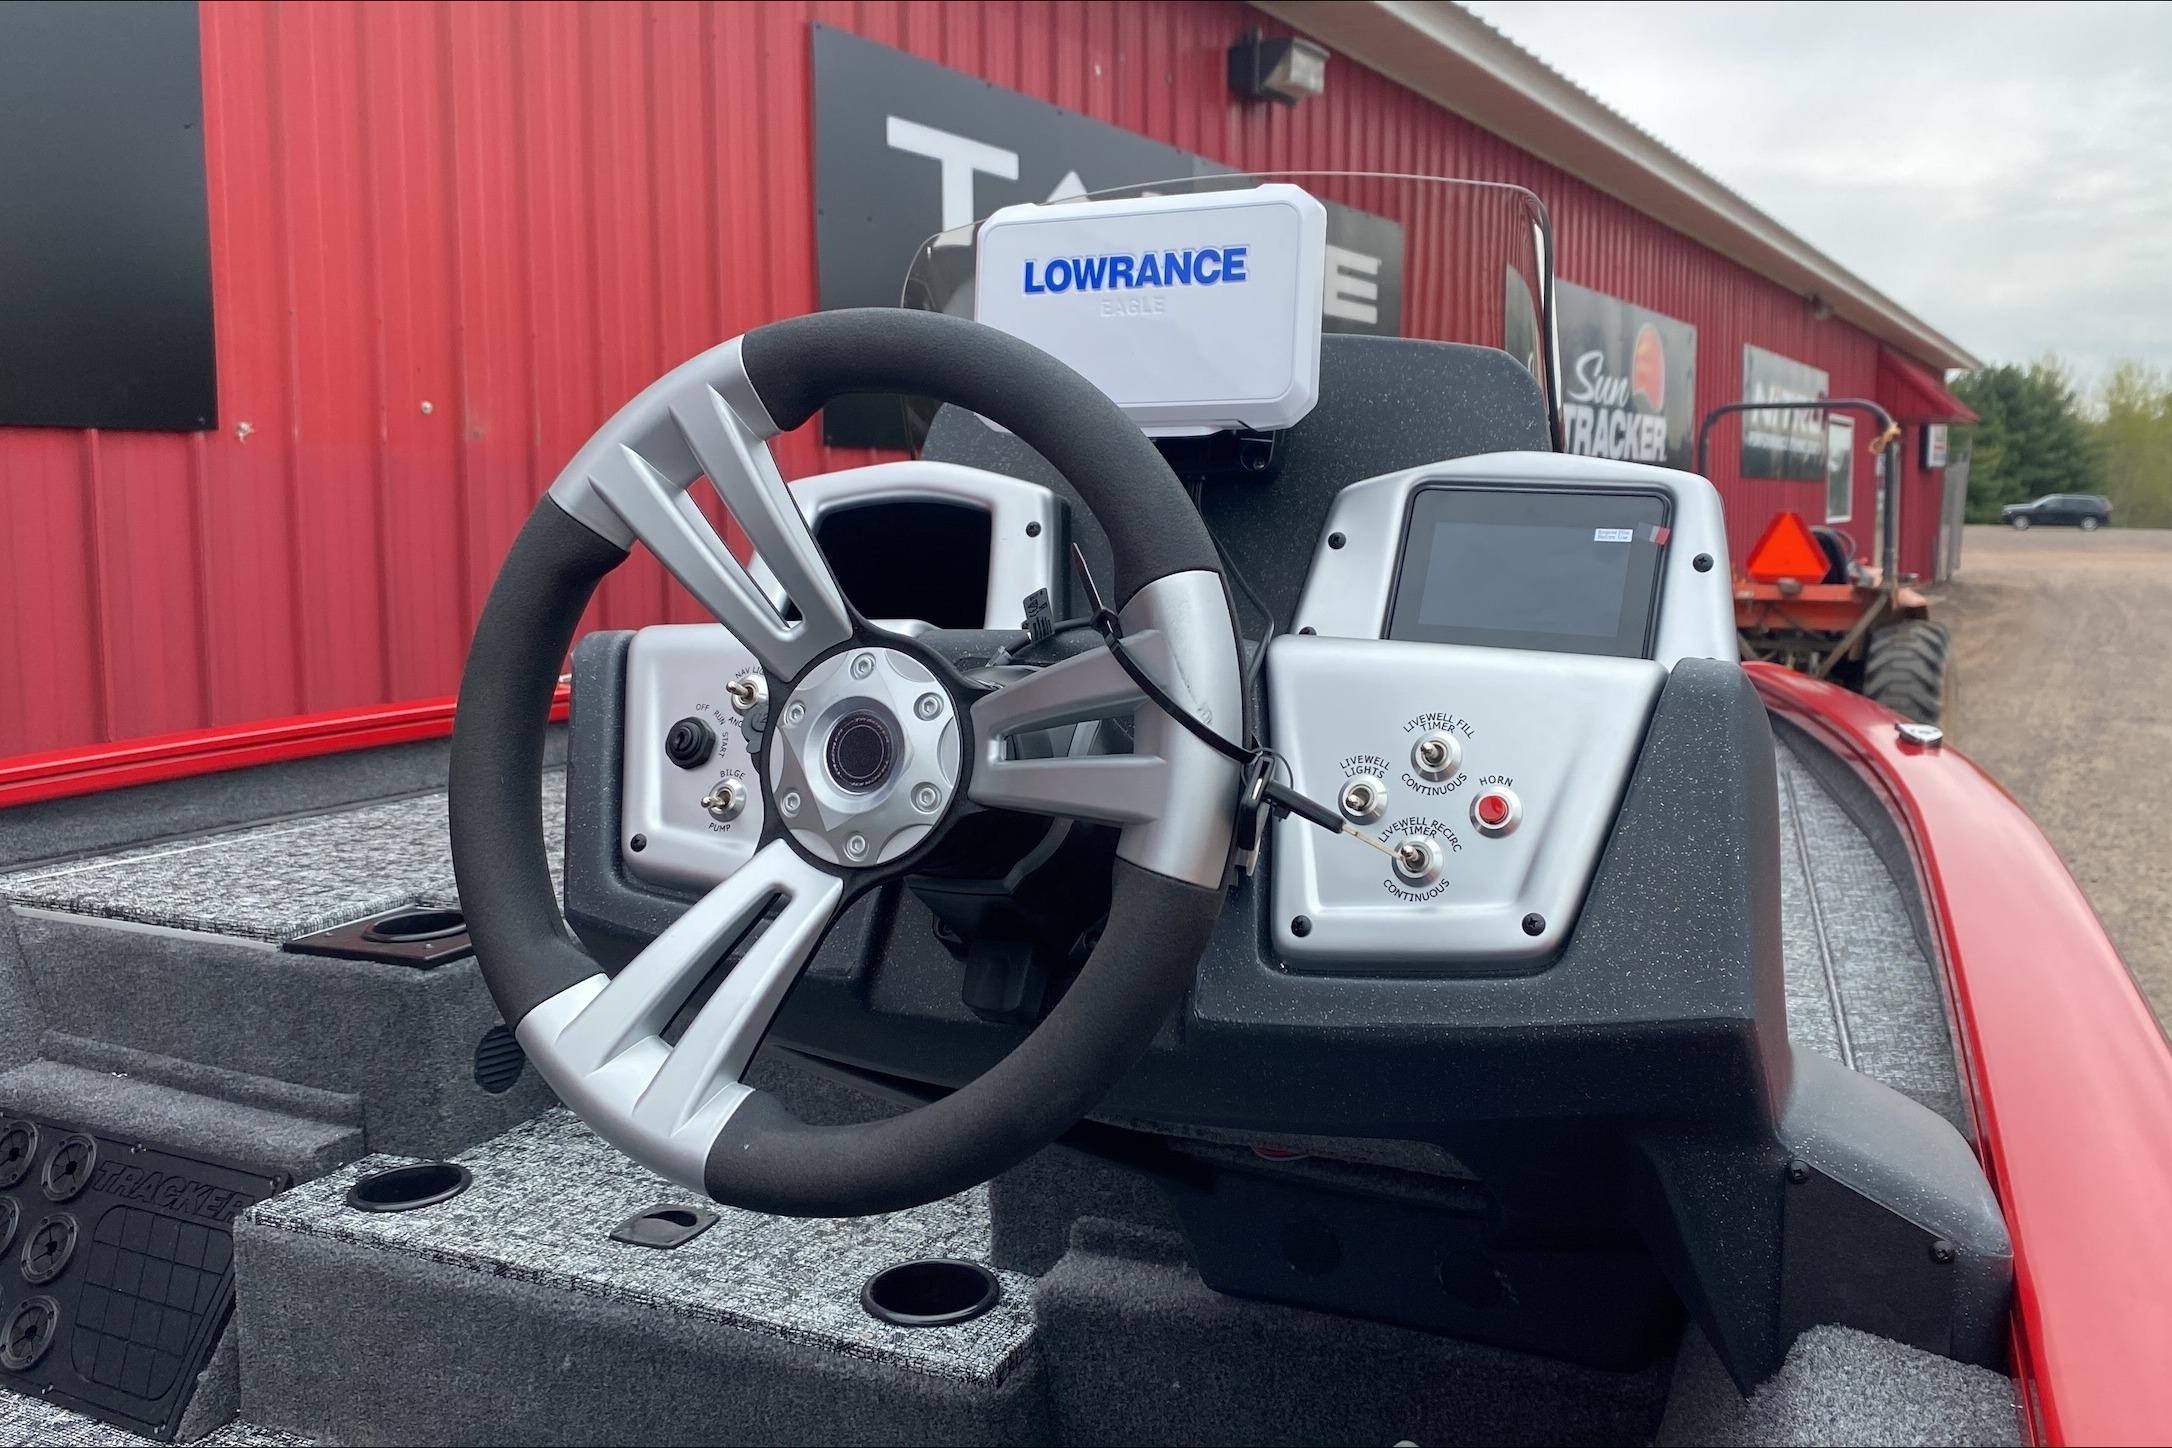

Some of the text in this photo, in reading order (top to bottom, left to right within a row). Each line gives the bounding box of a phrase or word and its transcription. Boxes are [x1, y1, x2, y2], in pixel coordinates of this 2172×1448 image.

[1023, 245, 1249, 294] LOWRANCE
[1102, 296, 1166, 316] EAGLE
[1568, 350, 1629, 405] Sun
[1564, 403, 1668, 462] TRACKER
[735, 667, 750, 679] NAV
[696, 703, 728, 758] OFF RUN START
[1403, 713, 1475, 739] LIVEWELL FILL
[1420, 721, 1456, 733] TIMER
[1339, 755, 1390, 771] LIVEWELL
[1345, 766, 1385, 778] LIGHTS
[720, 769, 745, 780] BILGE
[1401, 773, 1467, 795] CONTINUOUS
[1480, 775, 1513, 787] HORN
[708, 822, 731, 832] PUMP
[1378, 817, 1462, 852] LIVEWELL RECIRC
[1402, 826, 1437, 838] TIMER
[1383, 879, 1450, 902] CONTINUOUS
[92, 1160, 257, 1224] TRACKER
